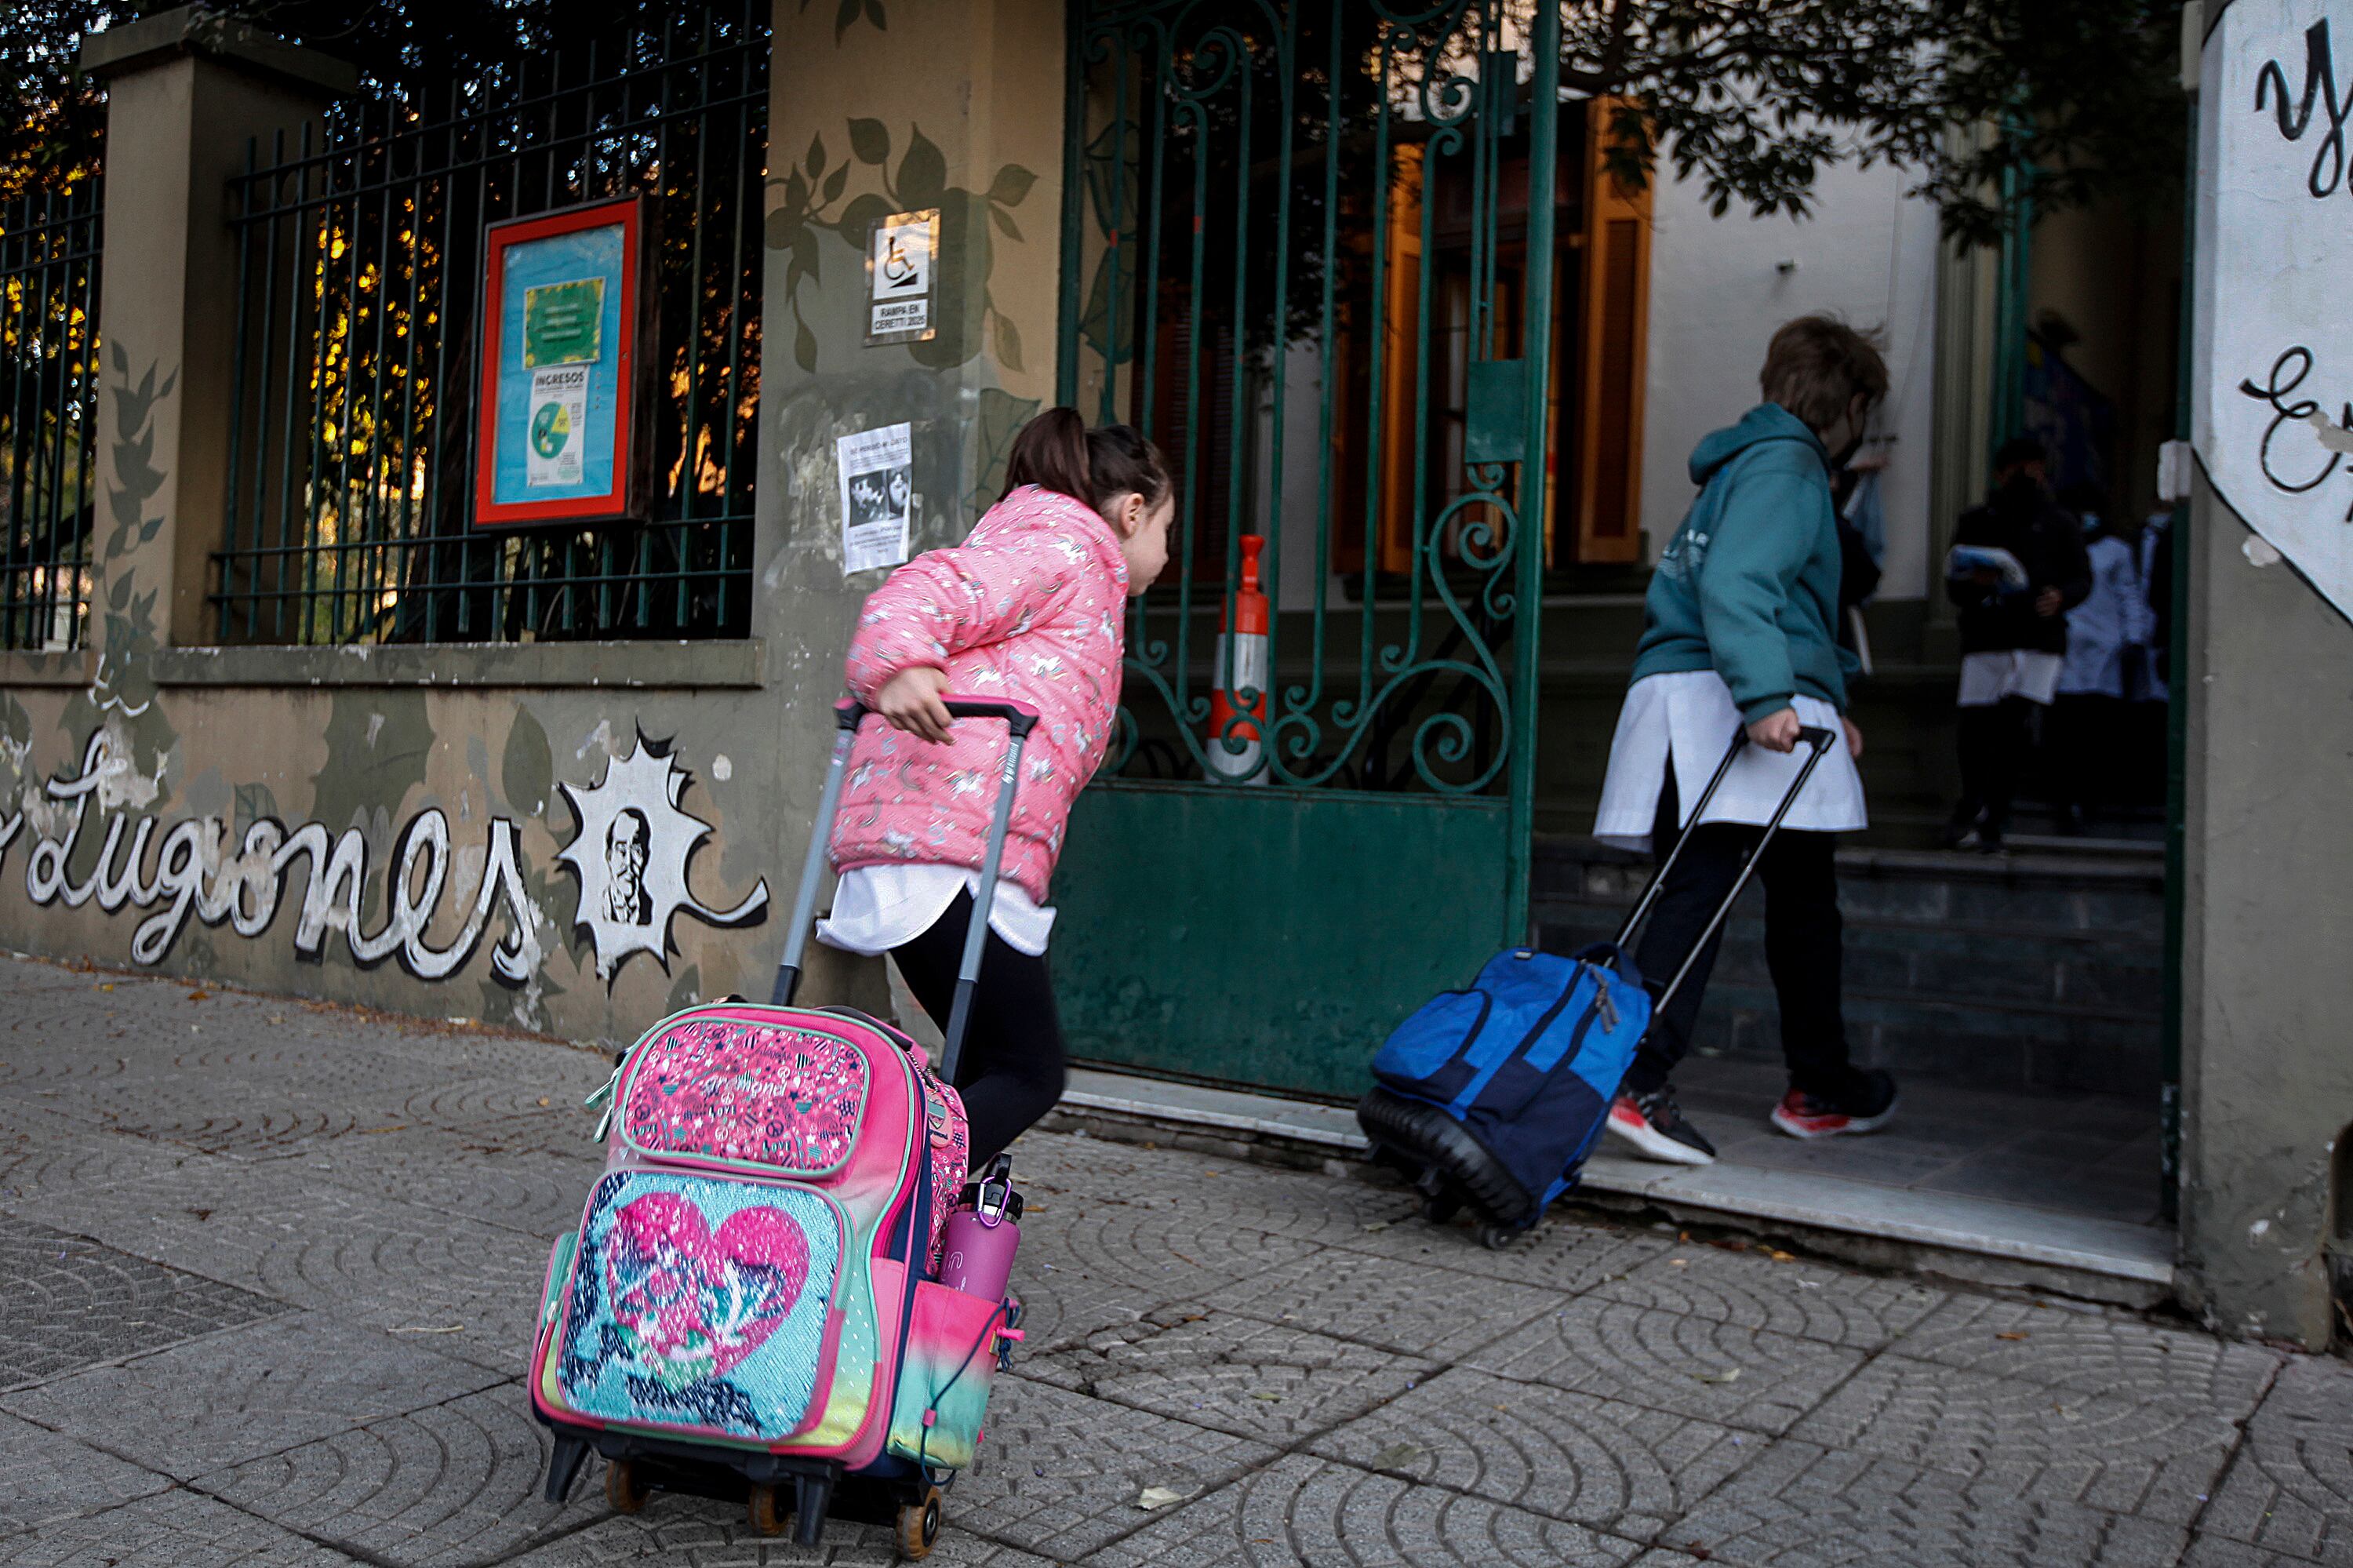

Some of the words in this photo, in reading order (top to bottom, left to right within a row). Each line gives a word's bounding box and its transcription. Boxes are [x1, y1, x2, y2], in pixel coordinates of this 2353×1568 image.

[881, 307, 907, 317] RAMPA
[909, 304, 920, 314] EN
[536, 372, 585, 386] INGRESOS
